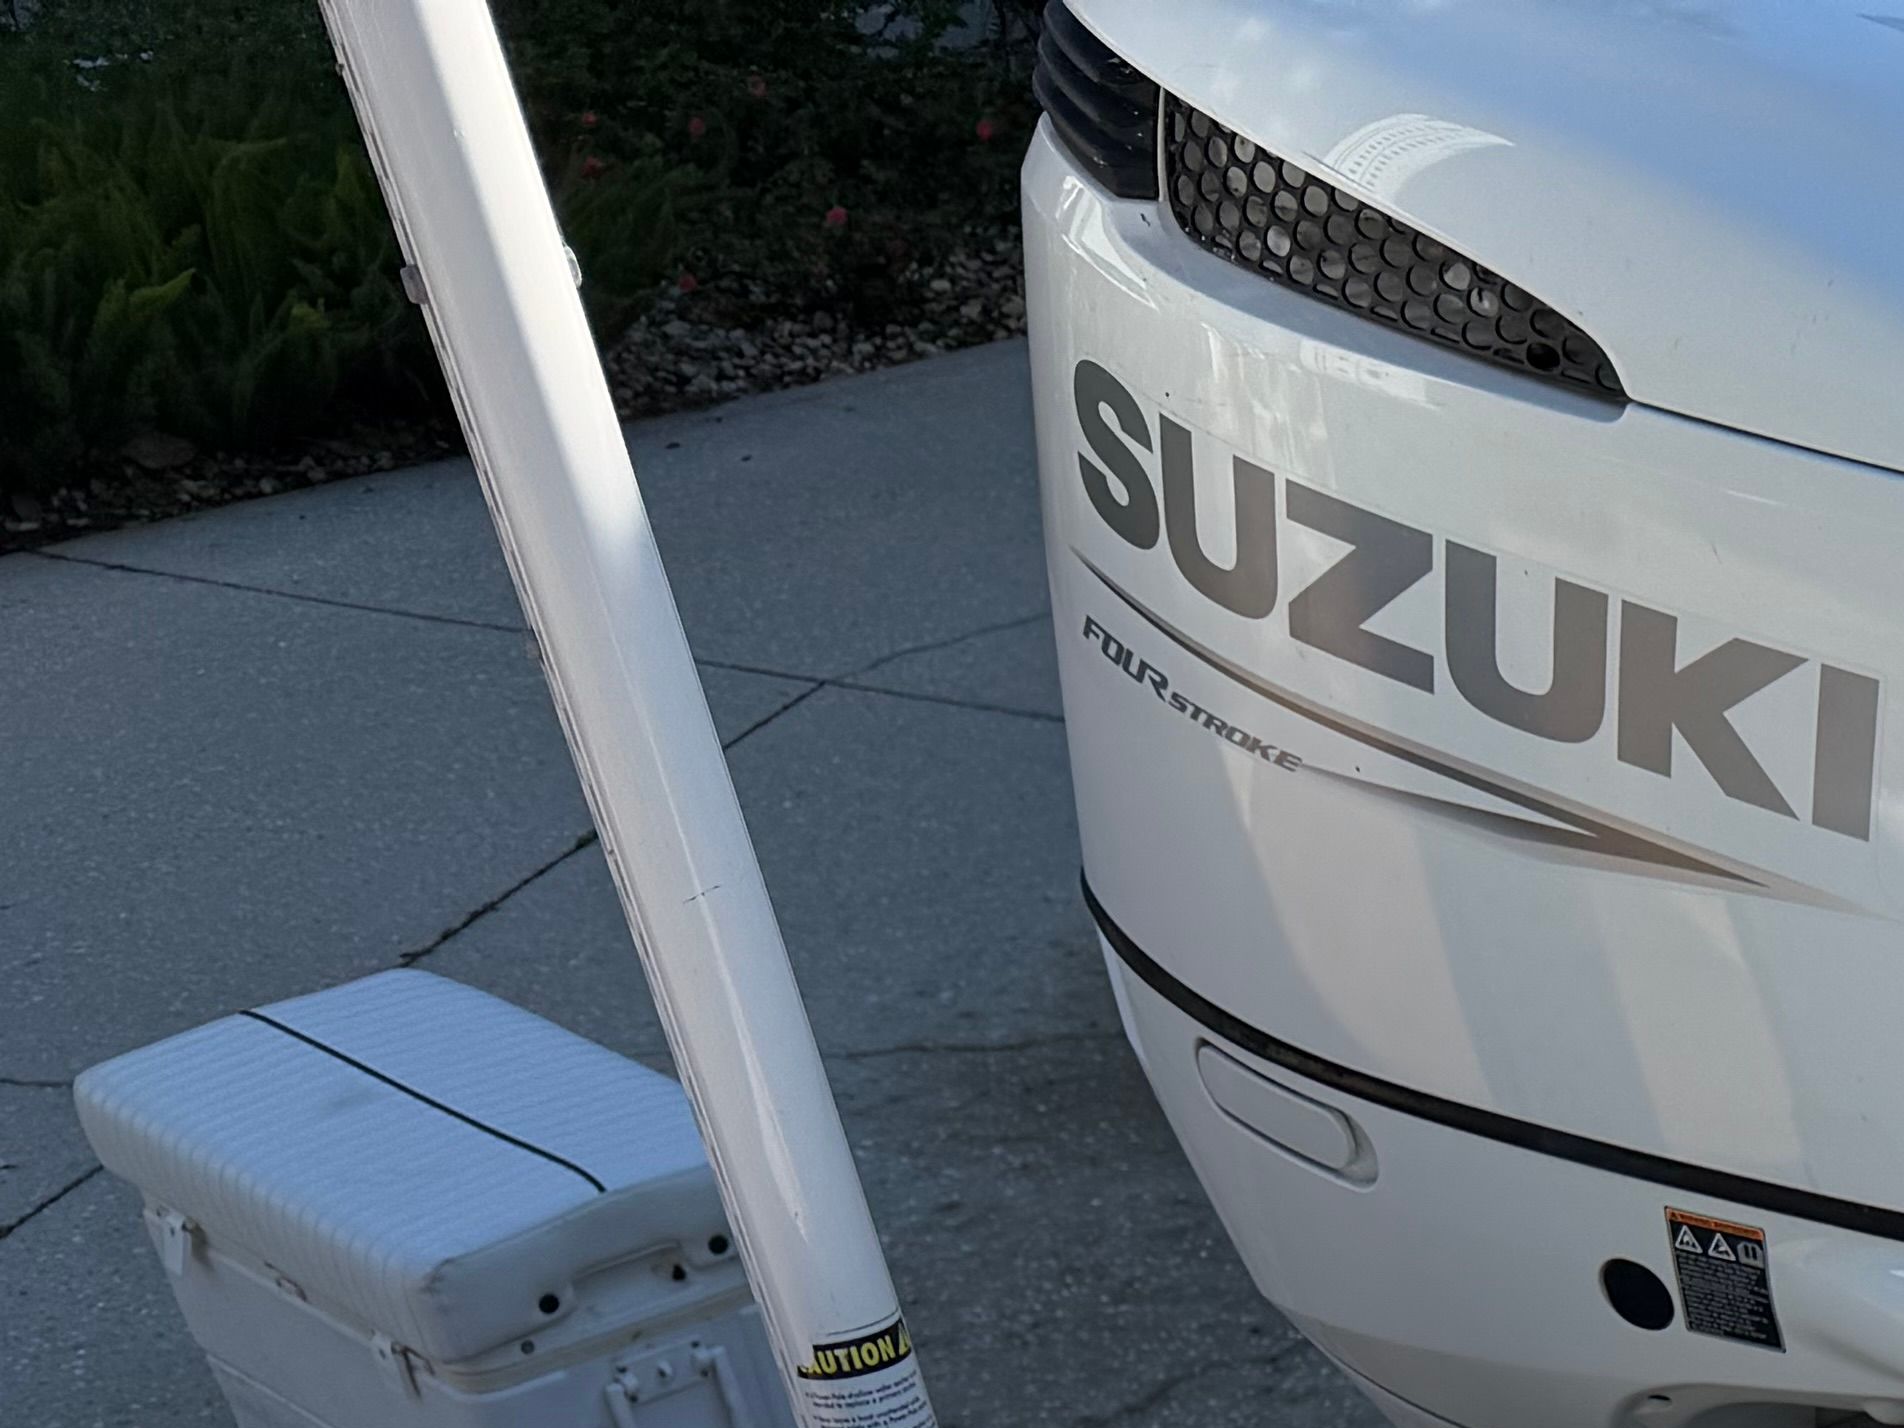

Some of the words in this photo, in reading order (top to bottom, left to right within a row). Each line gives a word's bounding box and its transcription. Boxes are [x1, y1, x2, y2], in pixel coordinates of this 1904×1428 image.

[1074, 359, 1880, 842] SUZUKI
[1083, 615, 1168, 702] FOUR
[1168, 692, 1302, 772] STROKE
[799, 1335, 896, 1375] UTION
